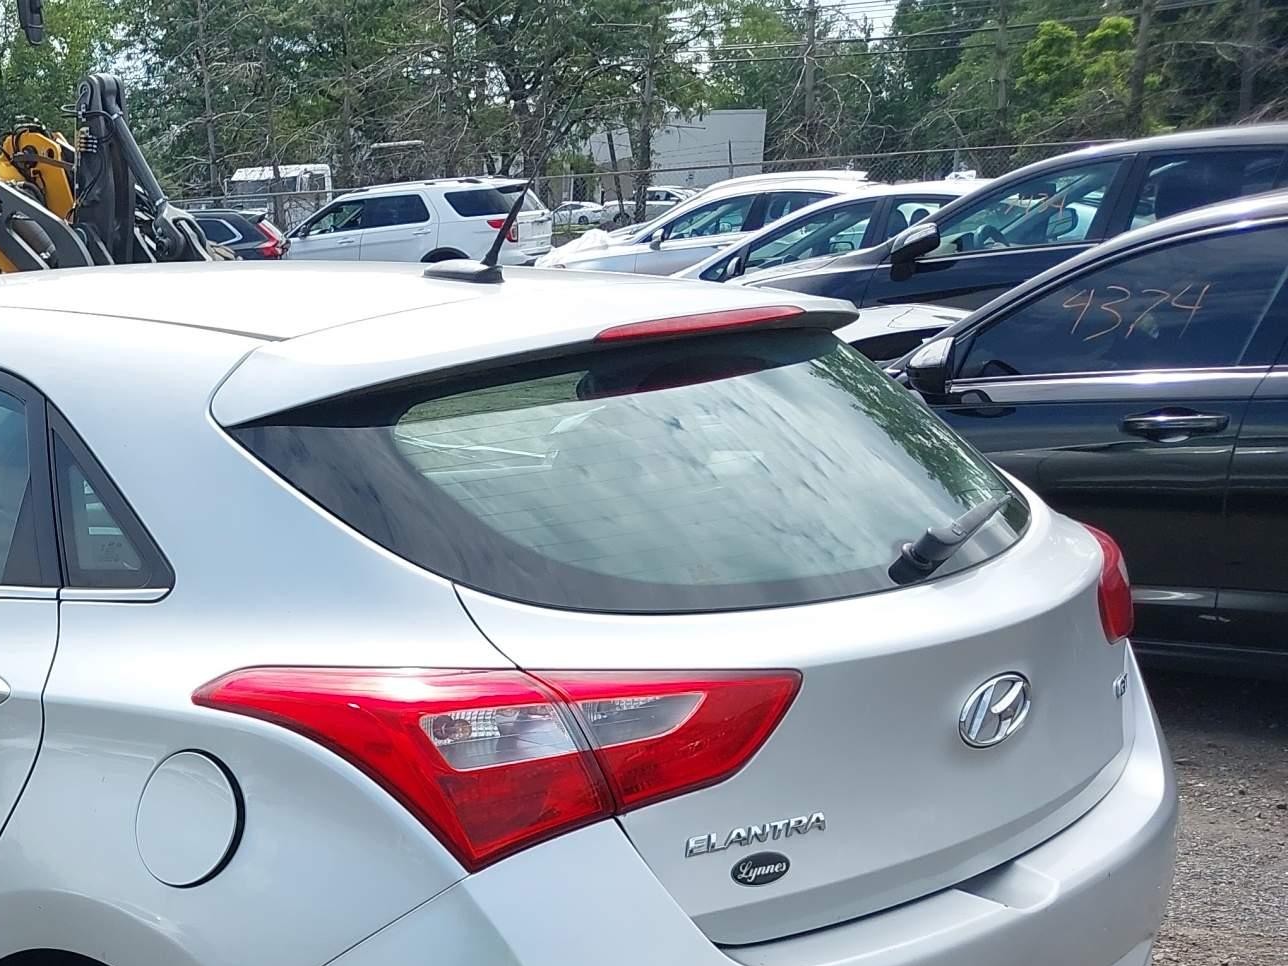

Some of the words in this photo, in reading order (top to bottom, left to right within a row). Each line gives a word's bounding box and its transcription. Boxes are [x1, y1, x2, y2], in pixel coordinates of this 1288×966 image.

[1063, 283, 1211, 342] 4374
[685, 811, 827, 859] ELANTRA
[737, 860, 788, 883] Lynnes
